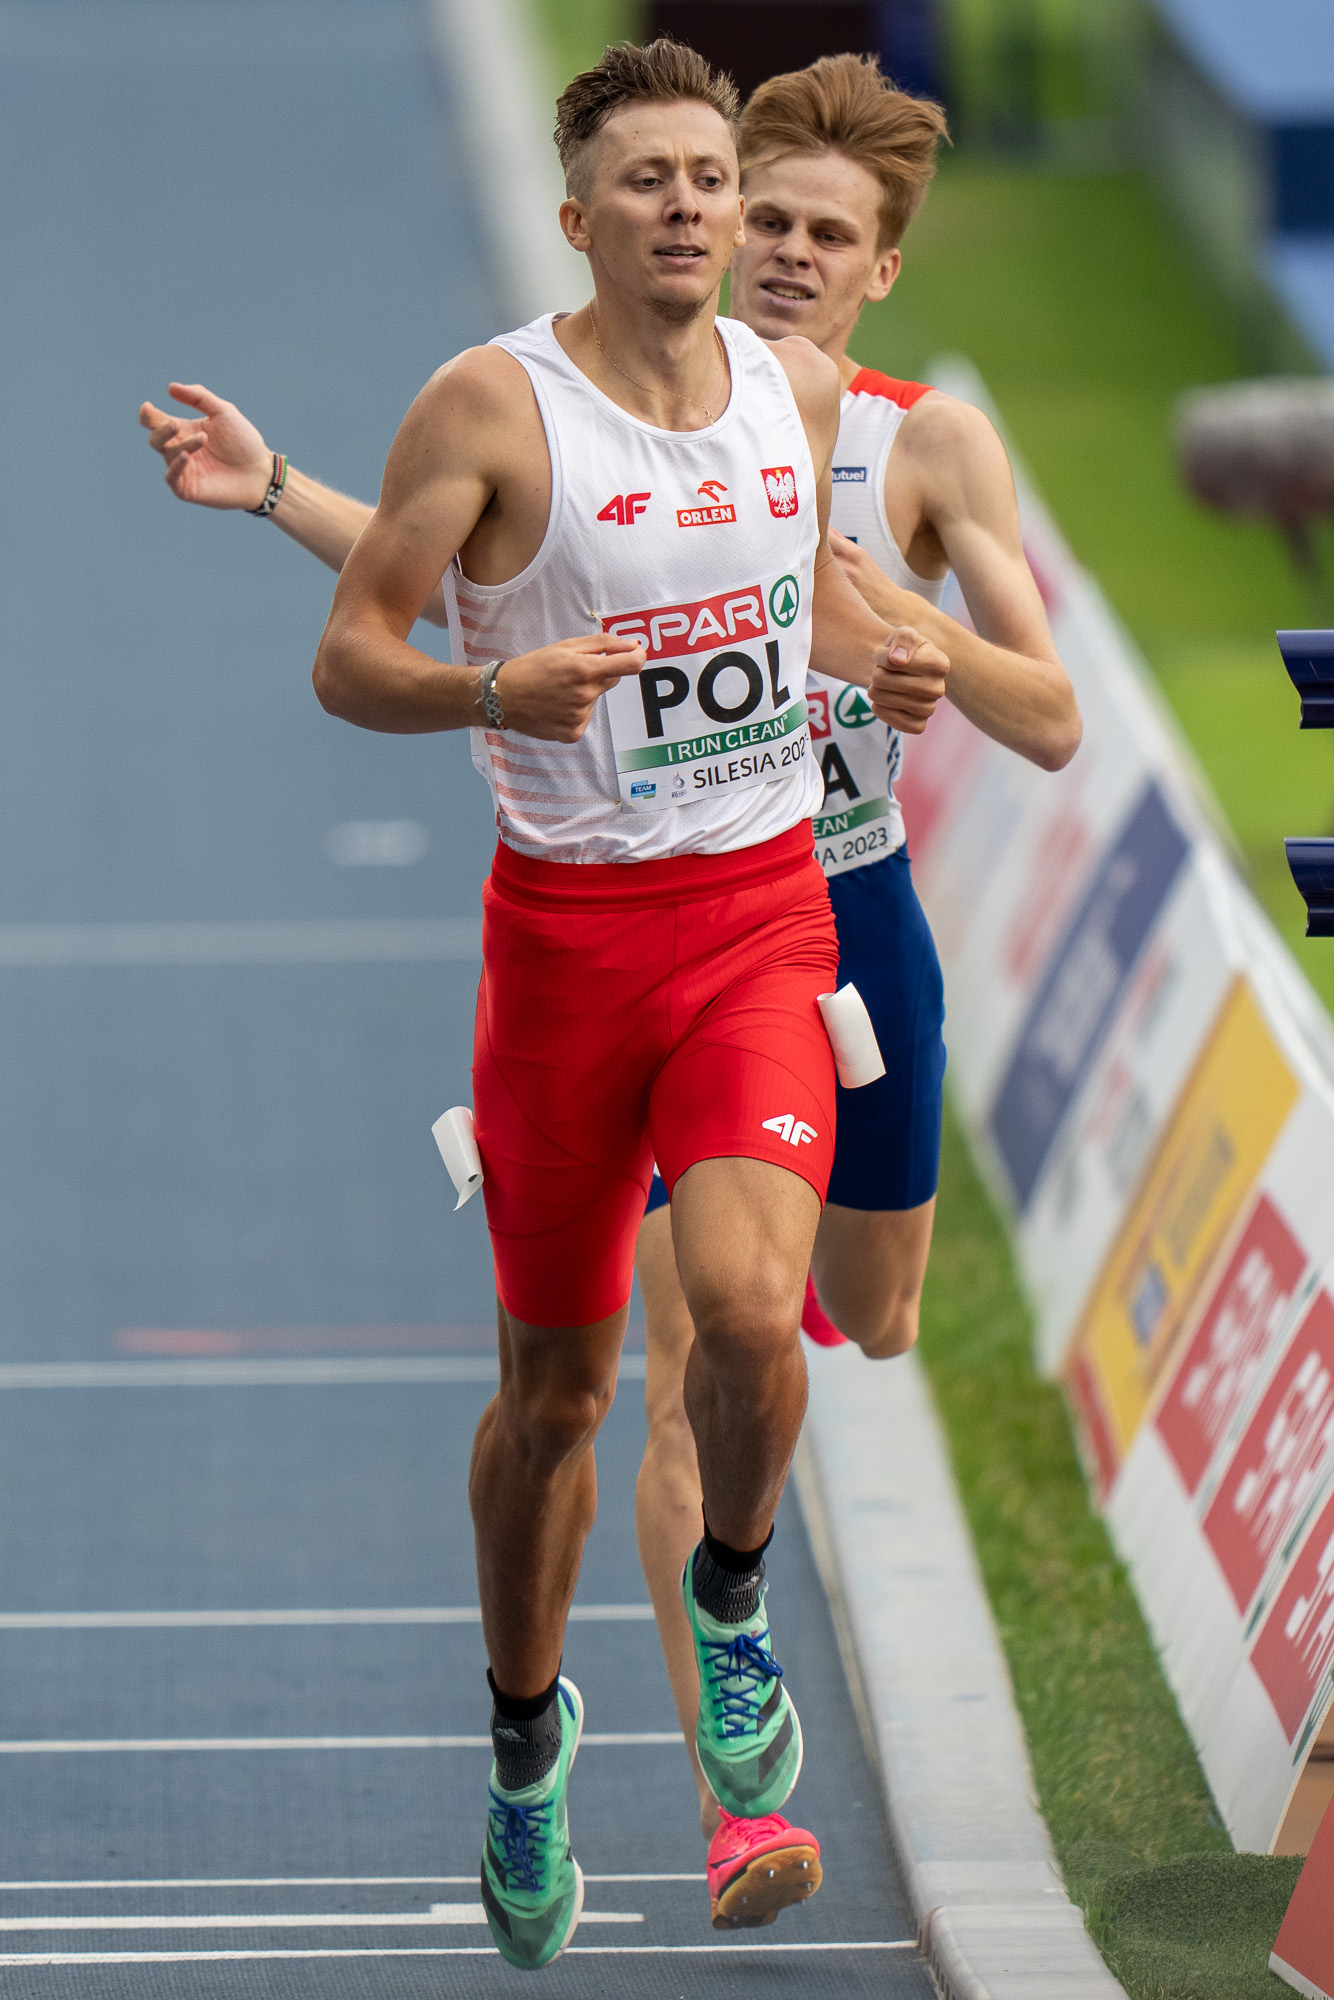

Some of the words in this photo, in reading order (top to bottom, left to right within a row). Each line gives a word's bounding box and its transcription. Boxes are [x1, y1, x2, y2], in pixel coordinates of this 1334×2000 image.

[597, 492, 651, 525] 4F
[680, 507, 733, 525] ORLEN
[608, 595, 763, 651] SPAR
[639, 639, 791, 739] POL
[667, 746, 673, 762] I
[678, 735, 721, 760] RUN
[693, 752, 776, 789] SILESIA
[781, 733, 808, 767] 202
[635, 785, 652, 793] TEAM
[842, 826, 888, 861] 2023
[761, 1113, 818, 1147] 4F
